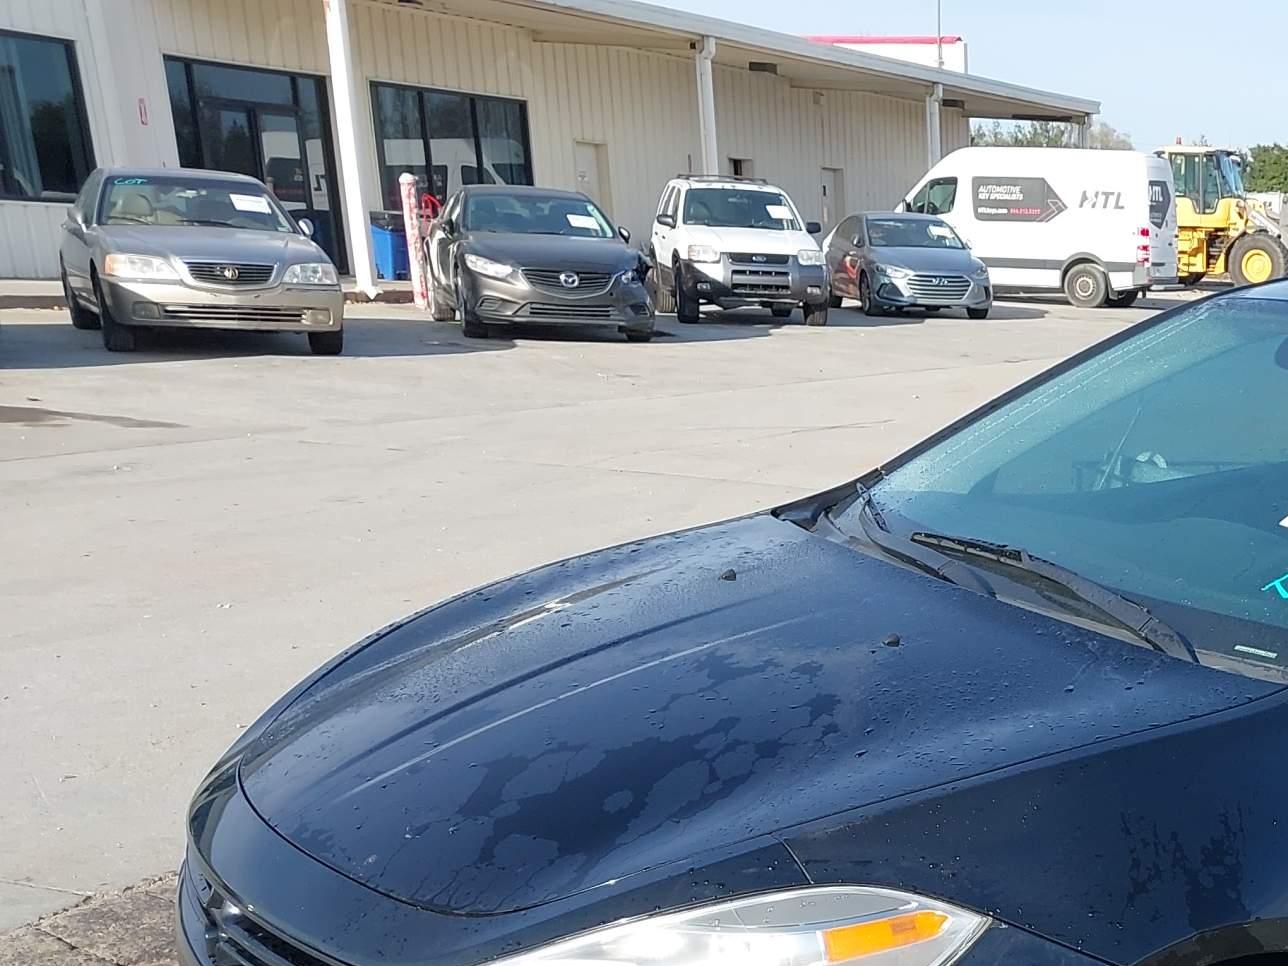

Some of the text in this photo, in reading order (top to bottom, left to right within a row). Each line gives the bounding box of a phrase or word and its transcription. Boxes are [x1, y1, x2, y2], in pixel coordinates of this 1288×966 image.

[978, 185, 1022, 194] AUTOMOTIVE
[990, 193, 1024, 201] SPECIALISTS
[1078, 190, 1125, 210] HTL
